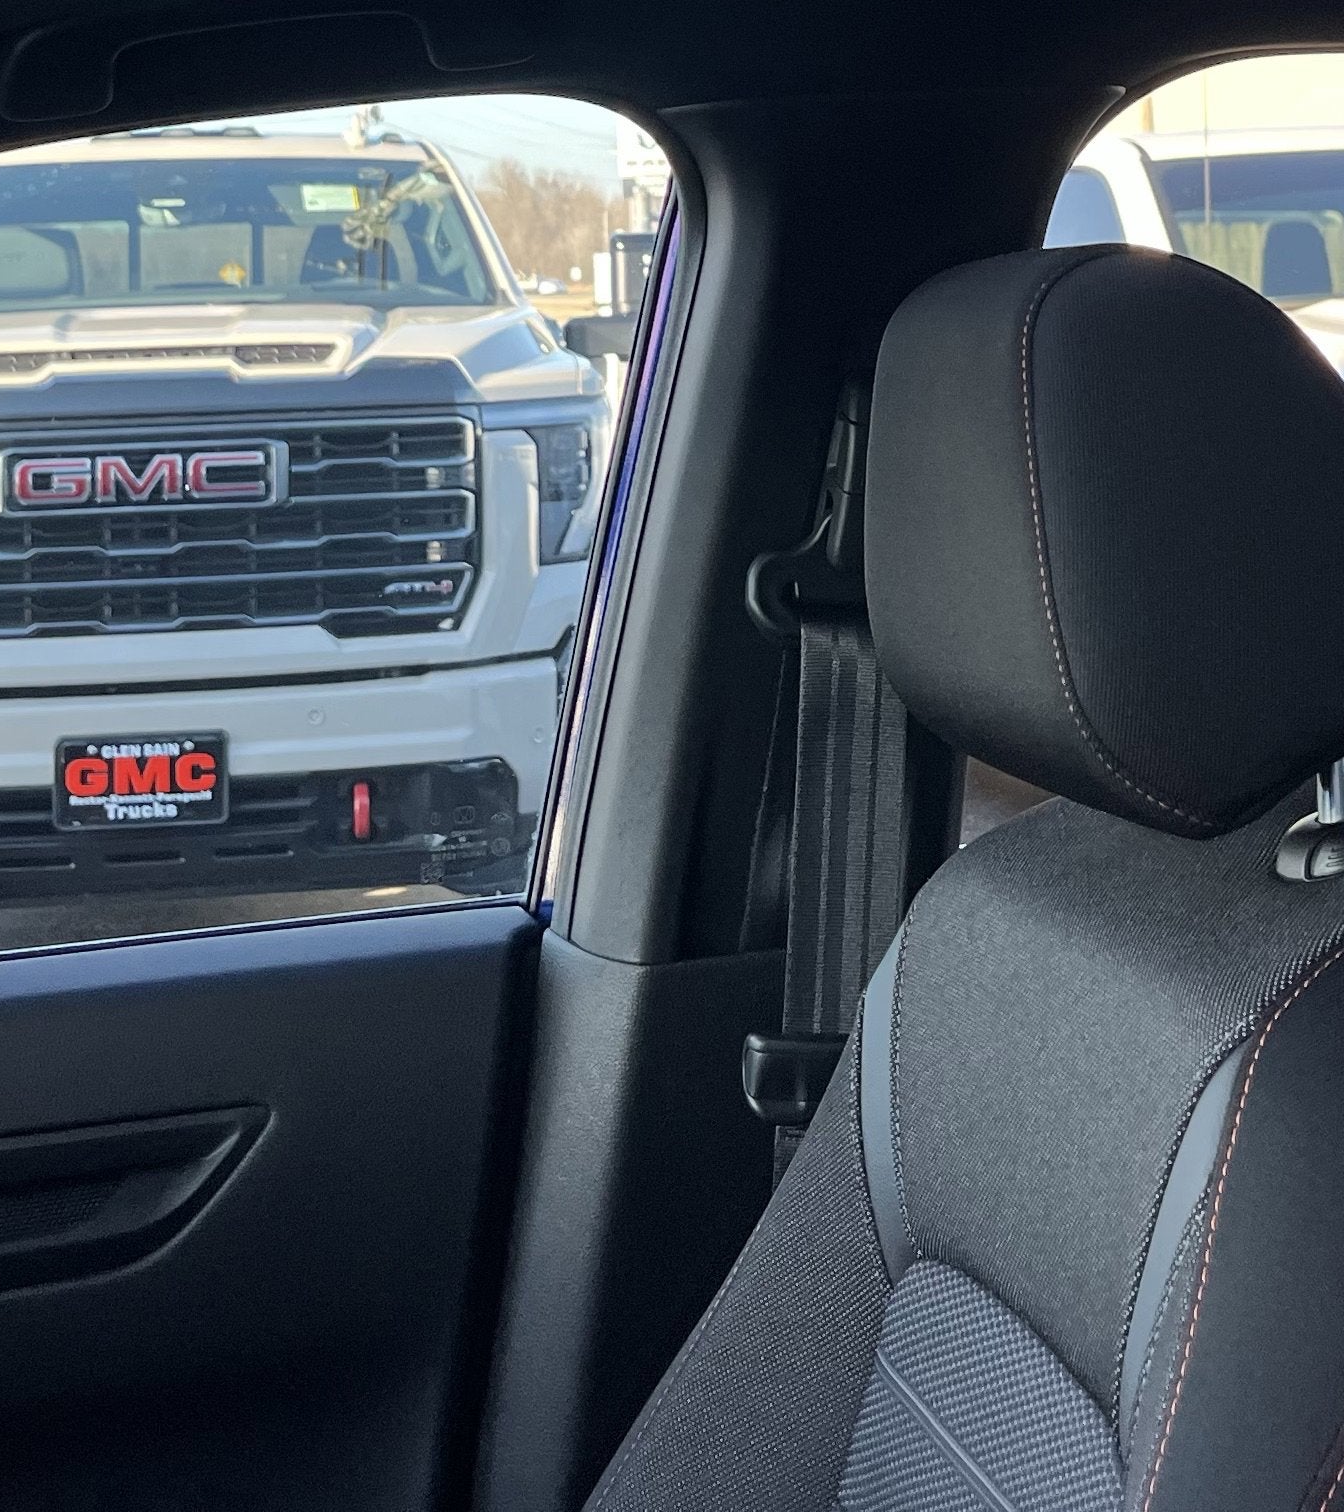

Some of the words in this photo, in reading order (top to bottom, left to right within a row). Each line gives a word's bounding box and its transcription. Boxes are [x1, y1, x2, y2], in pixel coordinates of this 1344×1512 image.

[14, 449, 266, 506] GMC
[65, 752, 217, 797] GMC
[104, 801, 178, 821] Trucks
